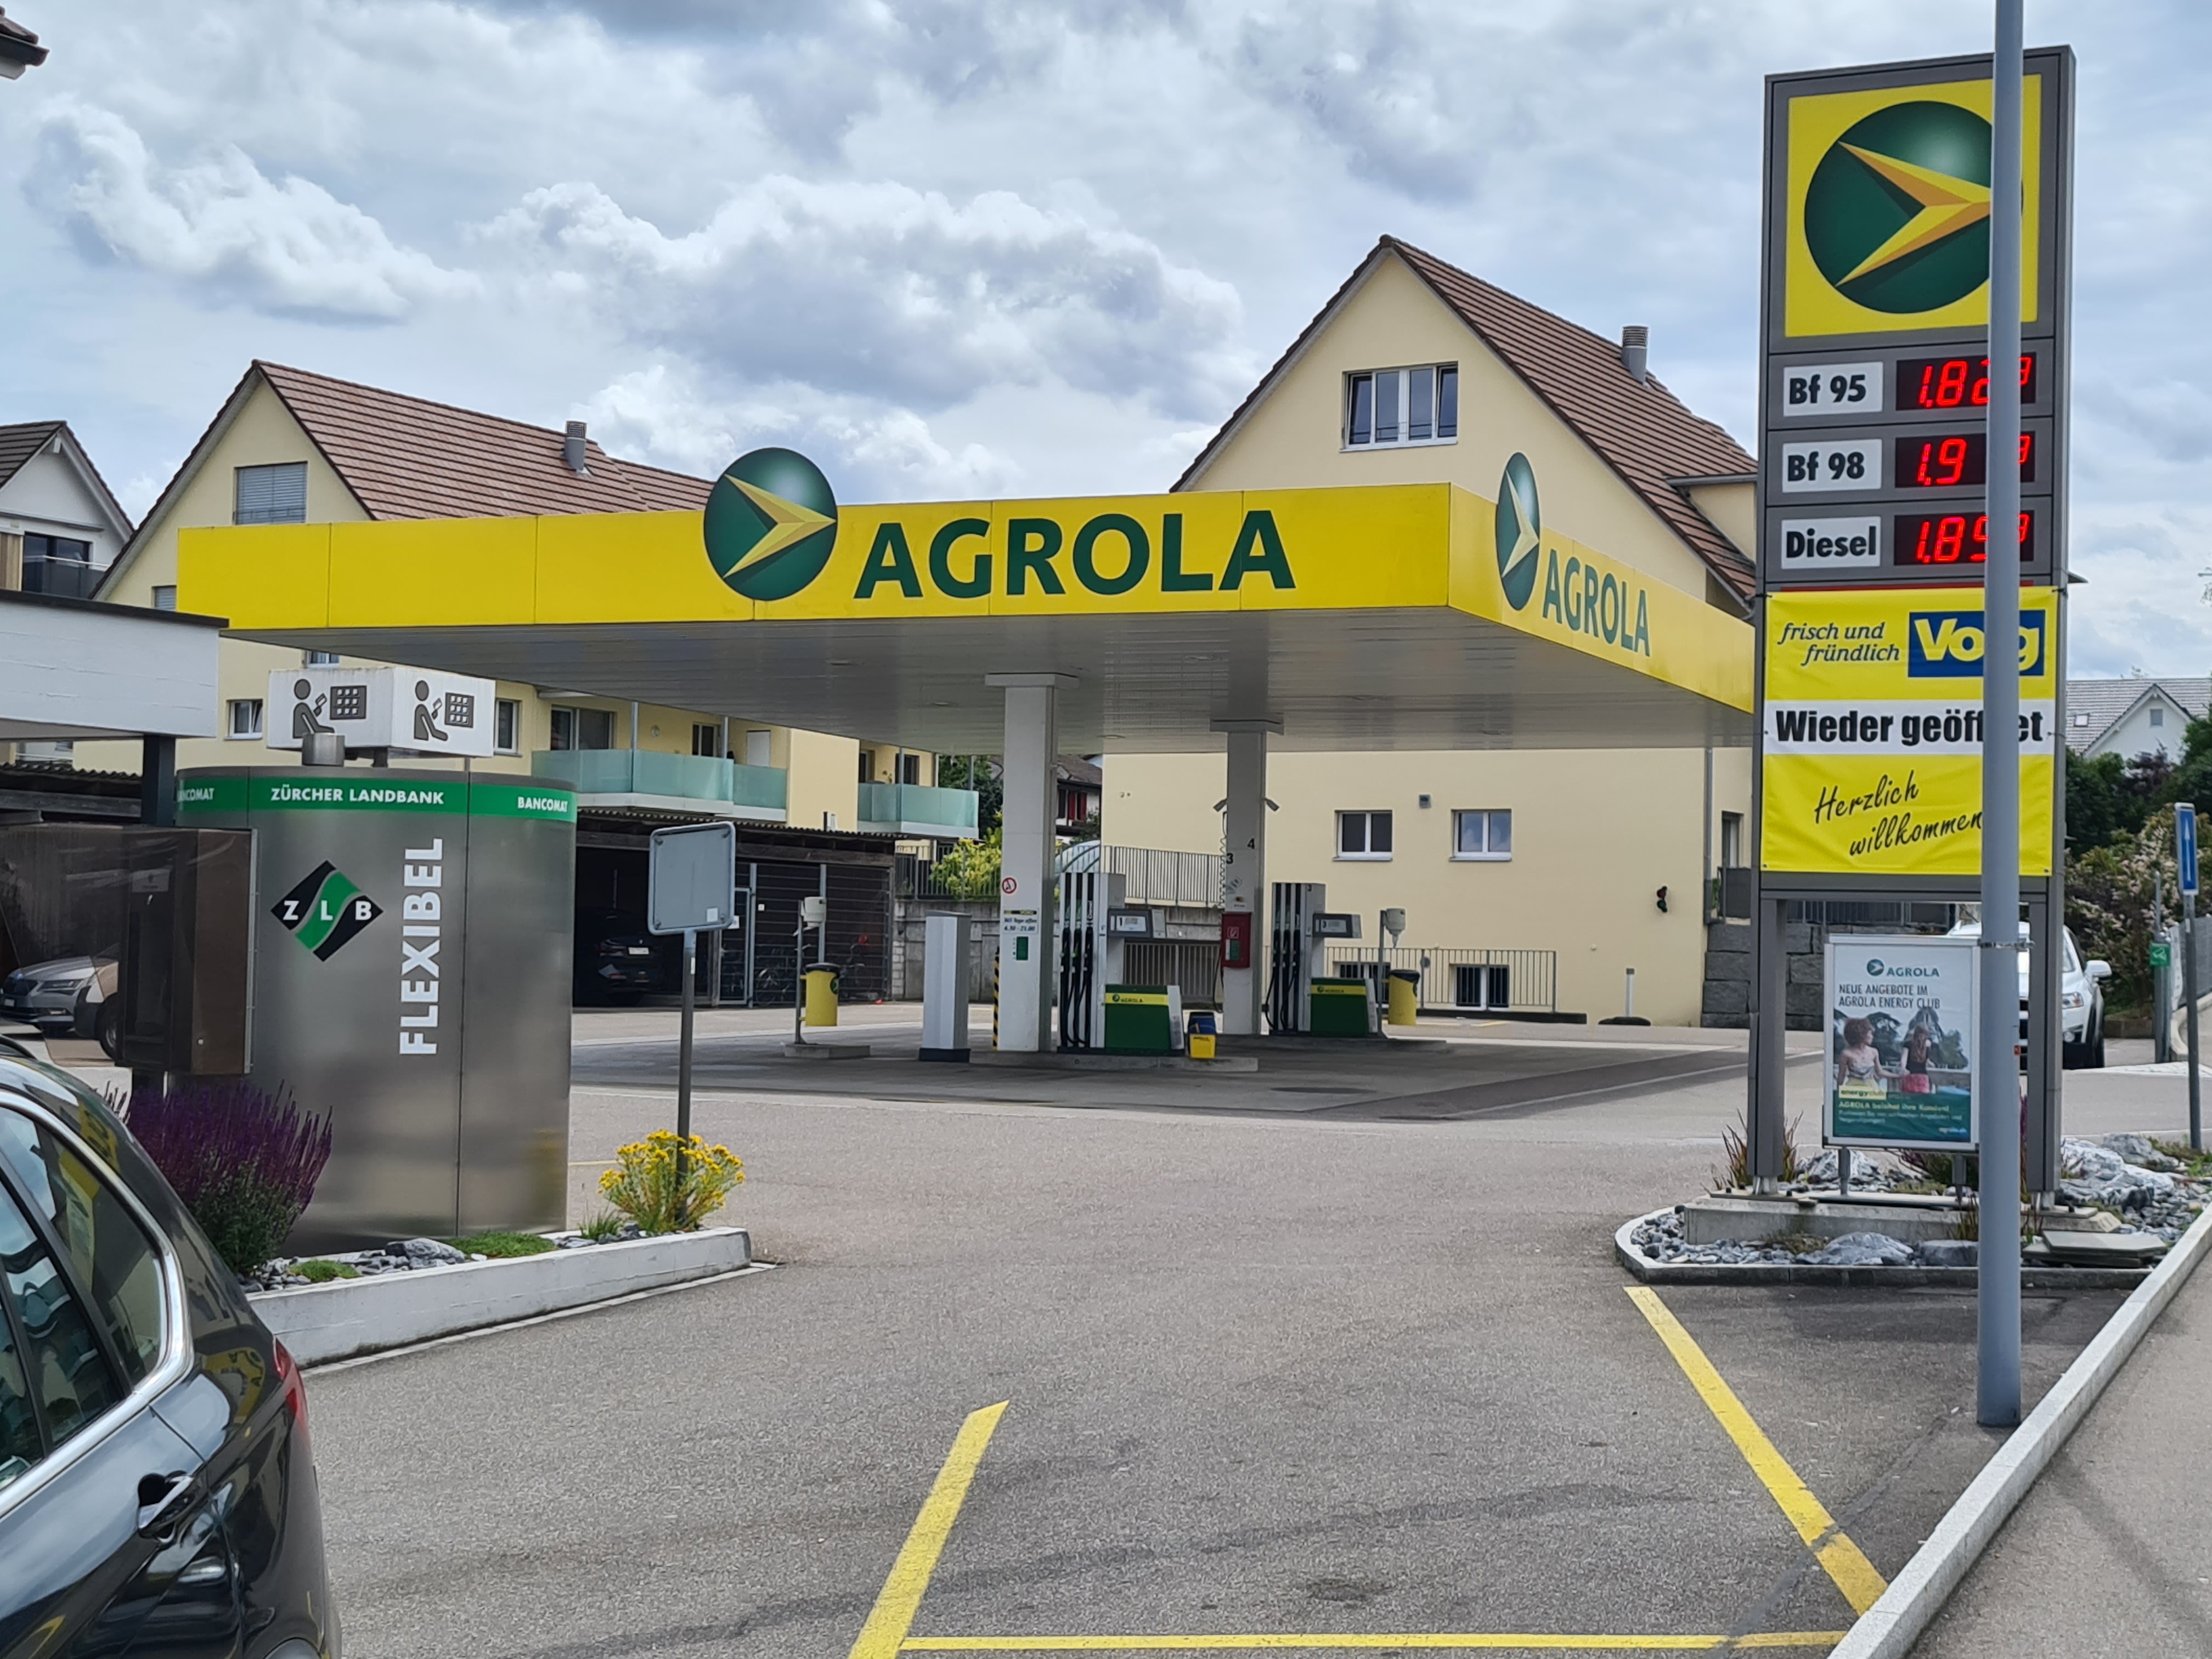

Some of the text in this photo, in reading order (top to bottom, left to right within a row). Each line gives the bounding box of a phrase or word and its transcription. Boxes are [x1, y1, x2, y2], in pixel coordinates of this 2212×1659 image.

[1789, 374, 1866, 404] Bf 95
[1787, 451, 1864, 482] Bf 98
[853, 510, 1295, 599] AGROLA
[1786, 526, 1876, 558] Diesel
[1543, 549, 1650, 657] AGROLA
[1778, 622, 1886, 645] frisch und
[1914, 618, 2040, 672] Vog
[1801, 644, 1900, 666] fründlich
[1776, 710, 1893, 742] Wieder
[271, 783, 444, 805] ZÜRCHER LANDBANK
[517, 796, 568, 813] BANCOMAT
[1814, 769, 1919, 824] Herzlich
[1247, 838, 1255, 850] 4
[1849, 811, 1983, 856] willkommen
[1226, 853, 1234, 865] 3
[399, 838, 443, 1054] FLEXIBEL
[1886, 967, 1940, 977] AGROLA
[1838, 996, 1940, 1009] AGROLA ENERGY CLUB
[1839, 984, 1928, 995] NEUE ANGEBOTE IM
